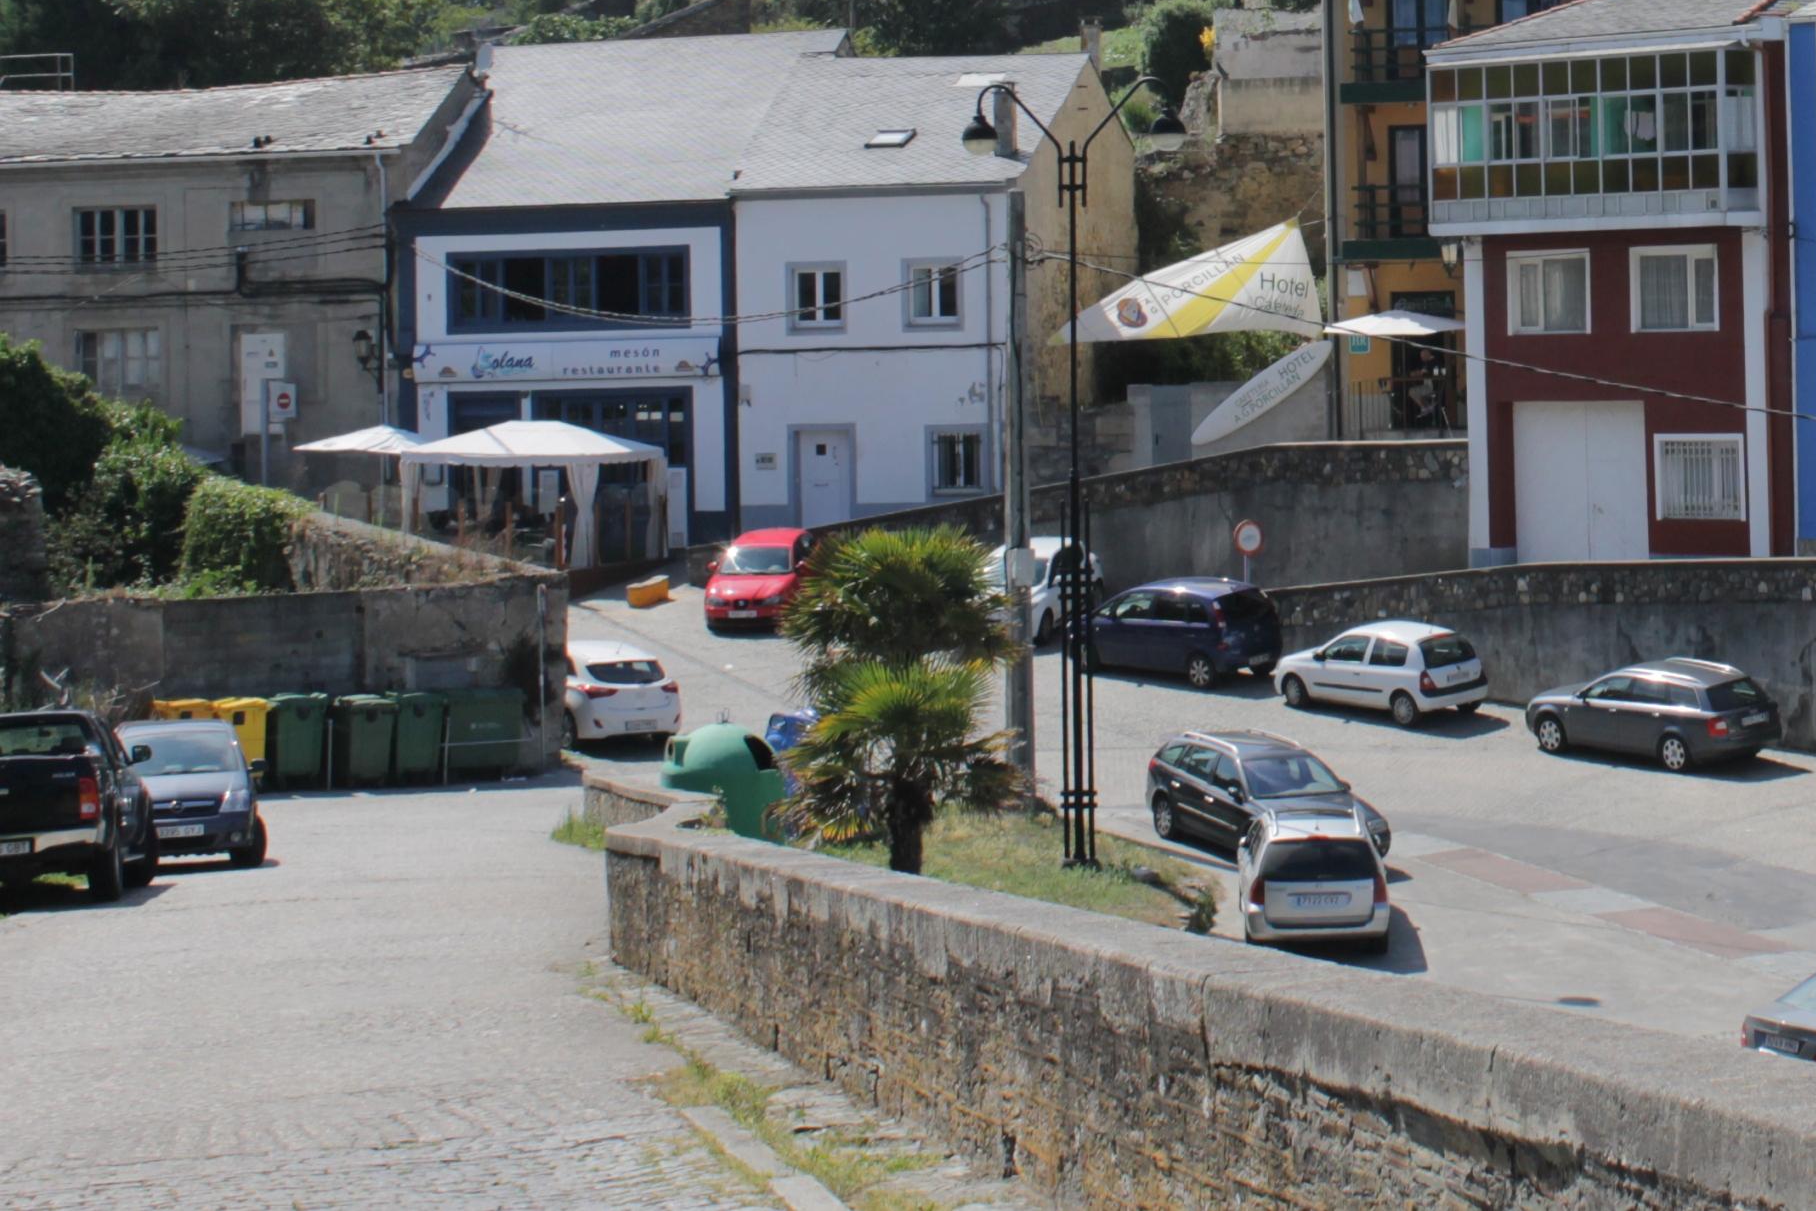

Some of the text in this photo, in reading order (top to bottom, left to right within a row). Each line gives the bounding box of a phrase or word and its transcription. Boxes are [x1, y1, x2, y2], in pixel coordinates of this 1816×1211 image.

[1162, 252, 1246, 307] PORCILLAN
[1260, 271, 1309, 298] Hotel
[610, 346, 660, 359] mesón
[1278, 350, 1316, 379] HOTEL
[562, 363, 661, 375] restaurante
